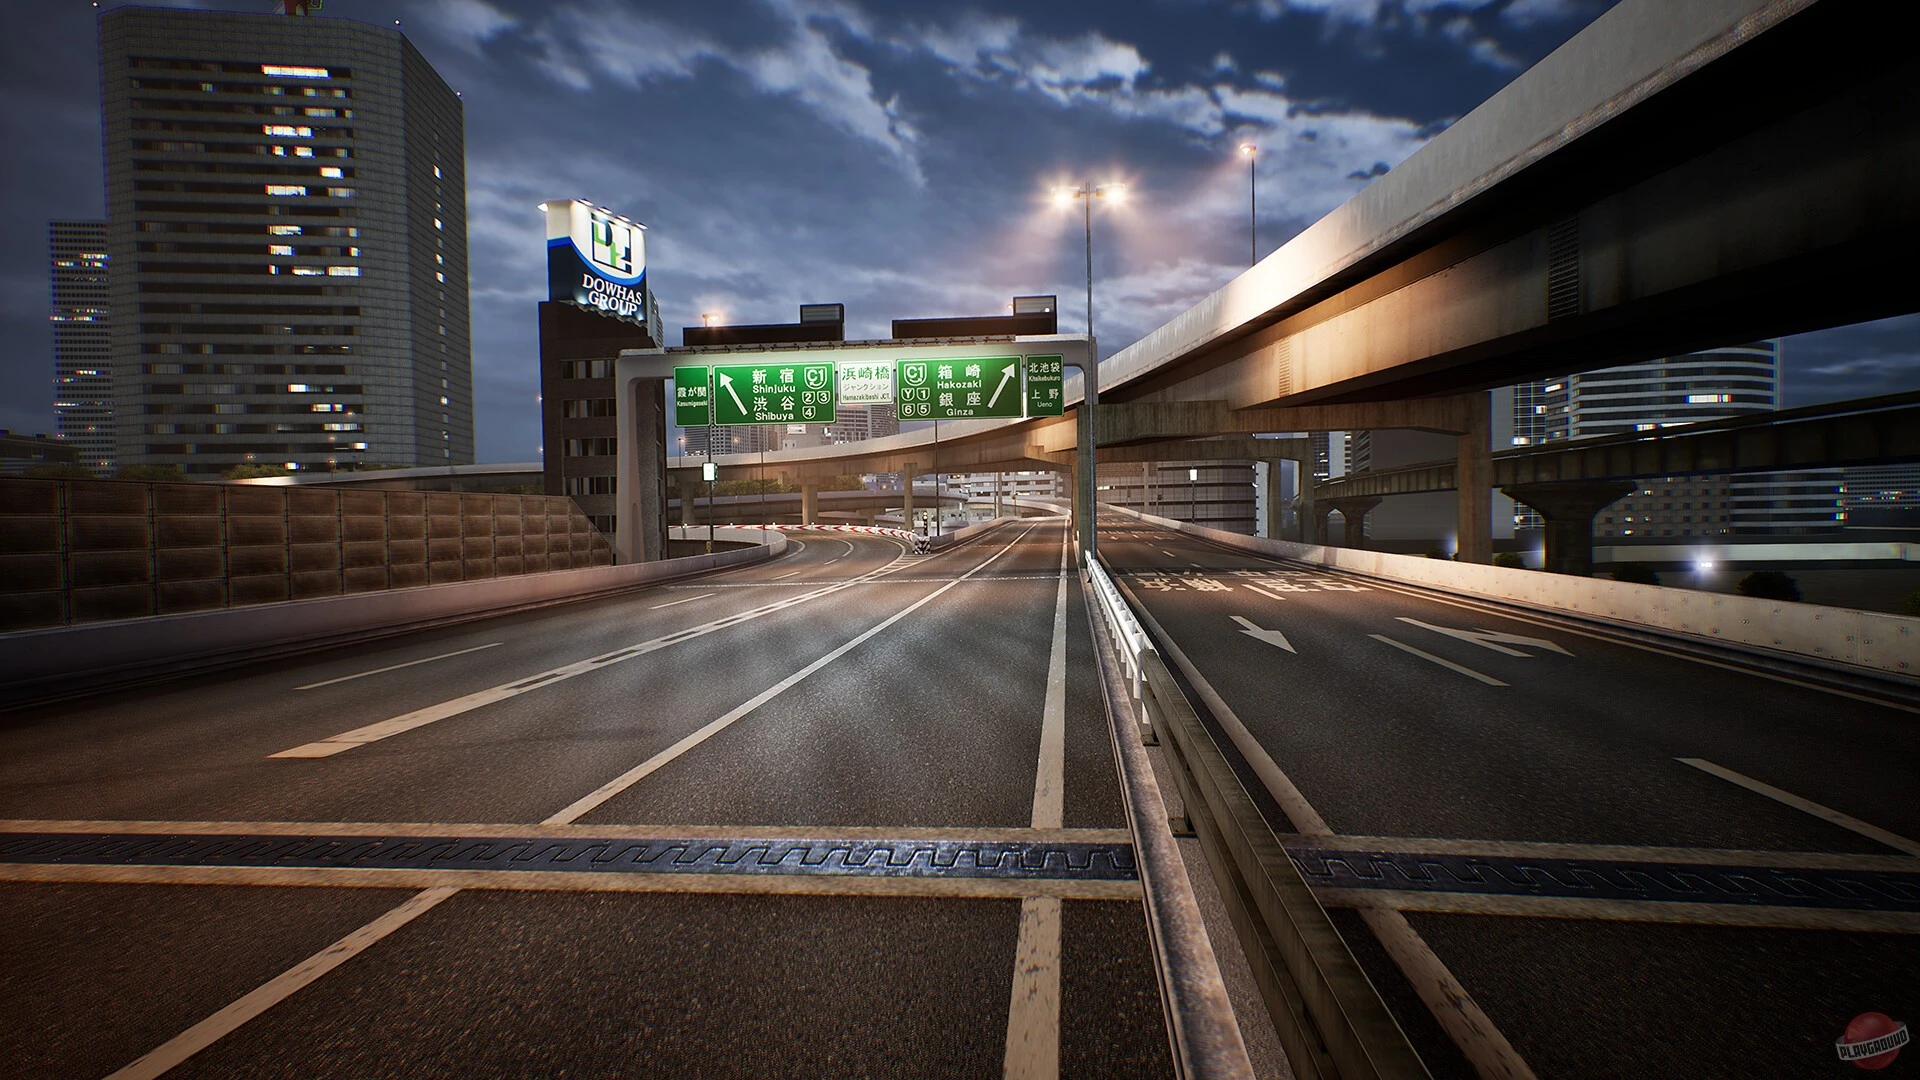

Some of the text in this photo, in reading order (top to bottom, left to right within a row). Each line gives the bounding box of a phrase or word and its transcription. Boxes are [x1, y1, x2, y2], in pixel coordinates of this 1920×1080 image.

[582, 273, 642, 305] DOWHAS
[588, 290, 638, 316] GROUP
[842, 366, 890, 380] 浜崎橋
[906, 366, 924, 379] C1
[937, 364, 981, 379] 箱崎
[1029, 362, 1060, 373] 北池袋
[752, 368, 794, 384] 新宿
[807, 369, 824, 381] C1
[752, 384, 796, 394] Shinjuku
[844, 383, 889, 391] ジャンクション
[937, 380, 982, 389] Hakozaki
[677, 386, 707, 397] 霞が関
[804, 392, 827, 402] 2 3
[903, 389, 926, 398] Y 1
[1031, 388, 1059, 400] 上野
[753, 395, 795, 411] 渋谷
[939, 392, 981, 407] 銀座
[804, 407, 812, 416] 4
[905, 405, 927, 414] 6 5
[946, 408, 974, 416] Ginza
[755, 412, 794, 421] Shibuya
